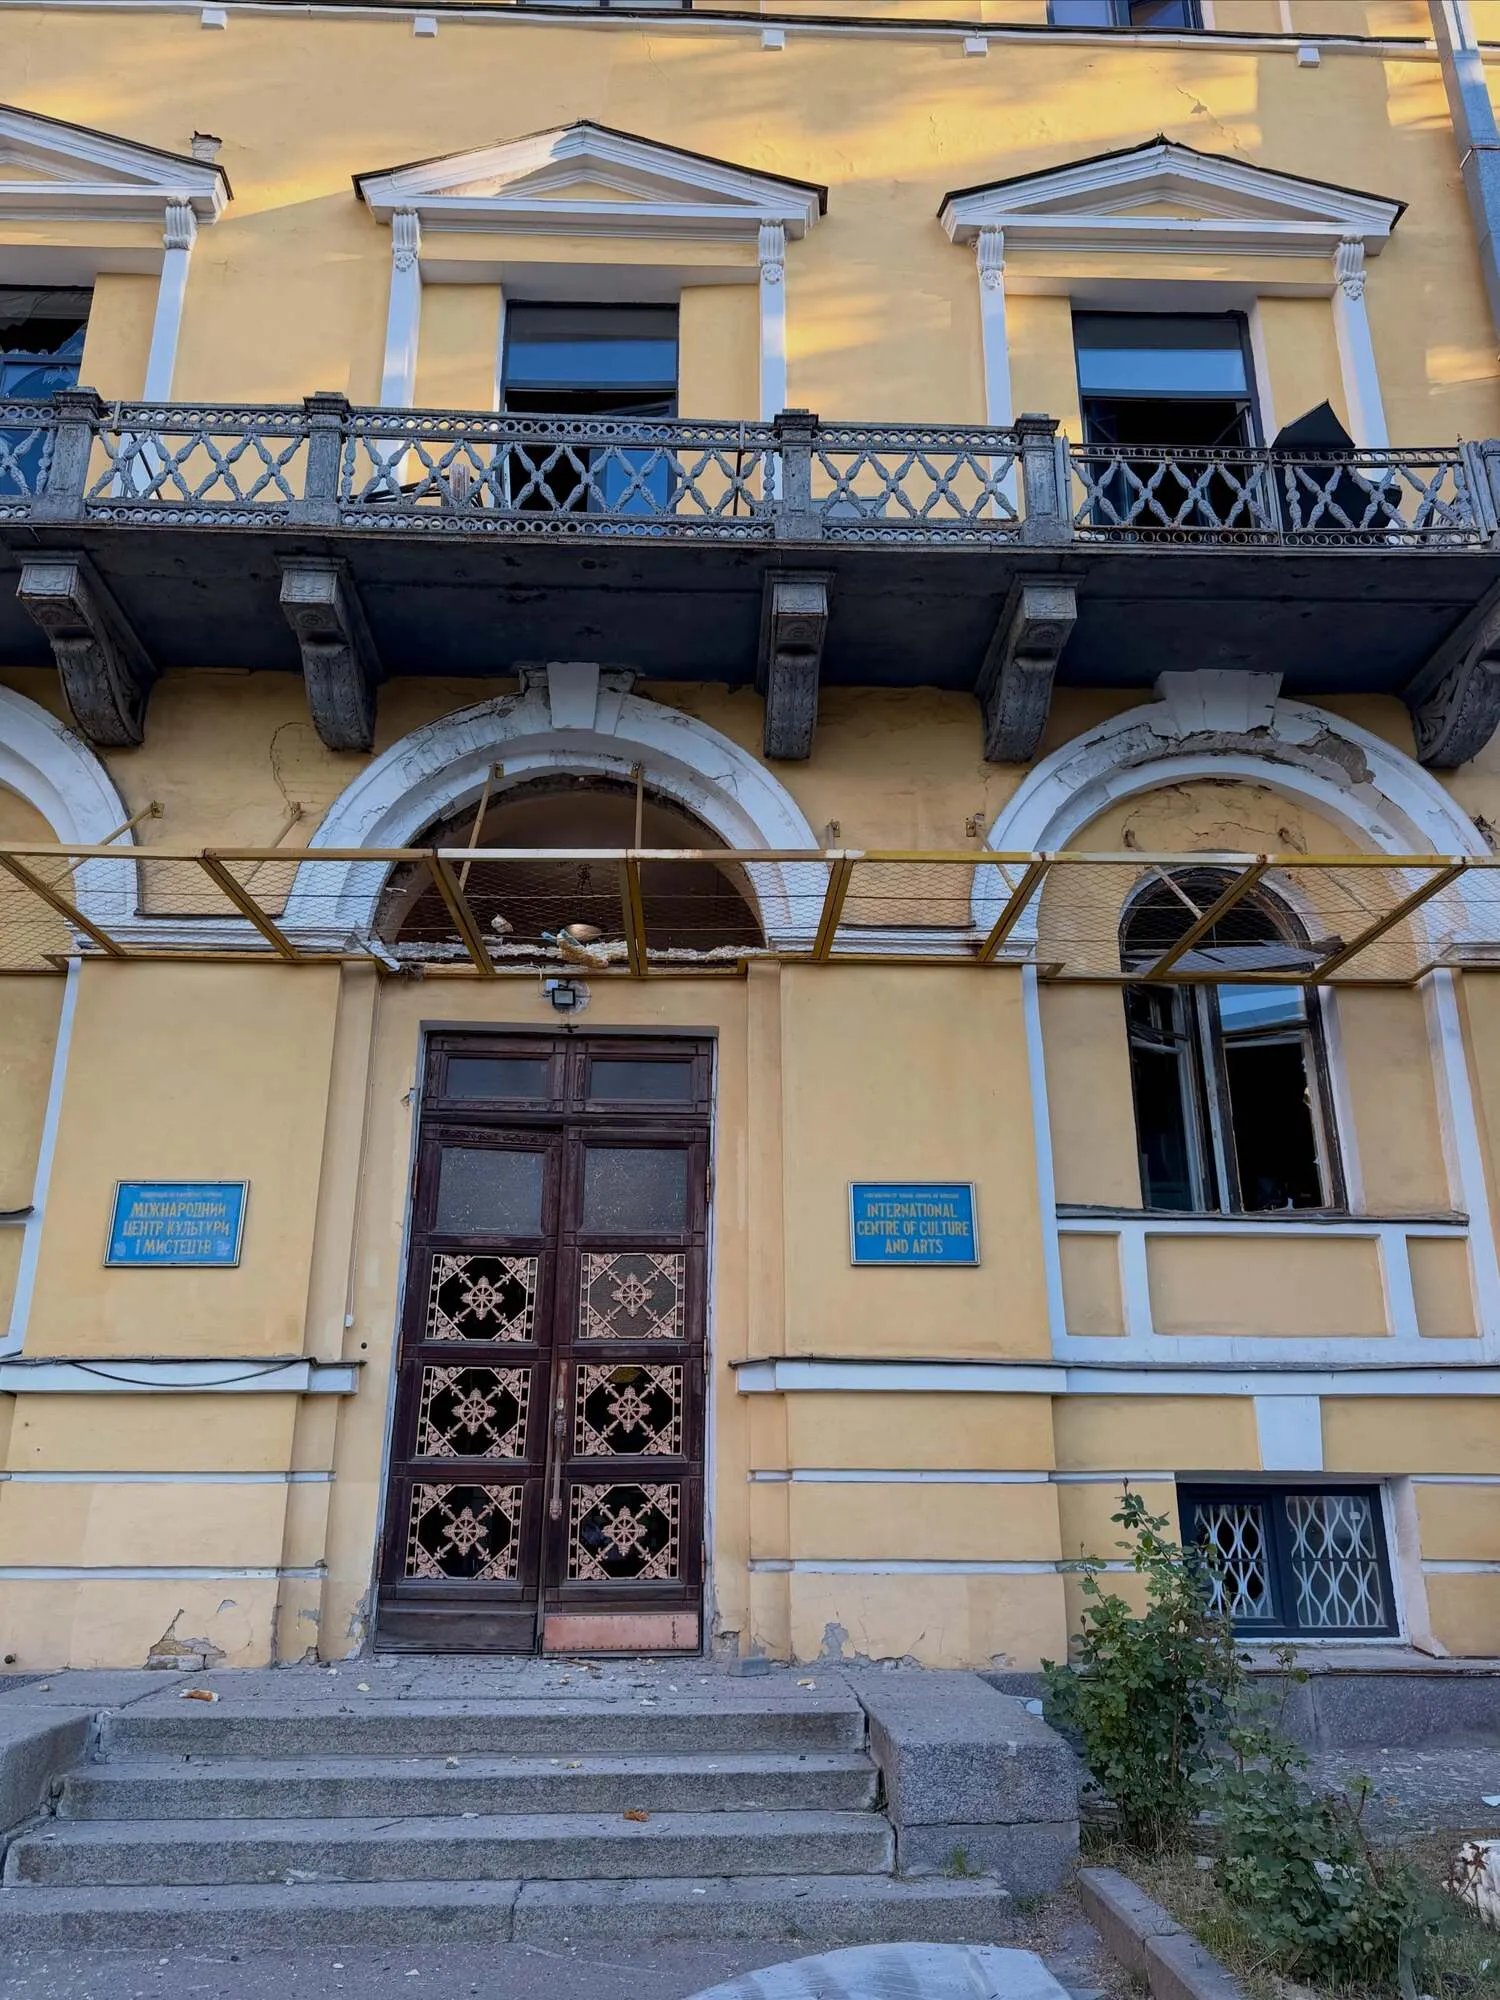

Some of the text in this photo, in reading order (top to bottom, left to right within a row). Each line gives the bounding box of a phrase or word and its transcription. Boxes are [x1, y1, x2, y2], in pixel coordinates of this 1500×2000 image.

[867, 1203, 958, 1218] INTERNATIONAL
[122, 1220, 230, 1237] ЦЕНТР КУЛЬТУРИ
[857, 1221, 970, 1236] CENTRE OF CULTURE
[135, 1239, 212, 1255] І МИСТЕЦТВ
[885, 1239, 944, 1254] AND ARTS
